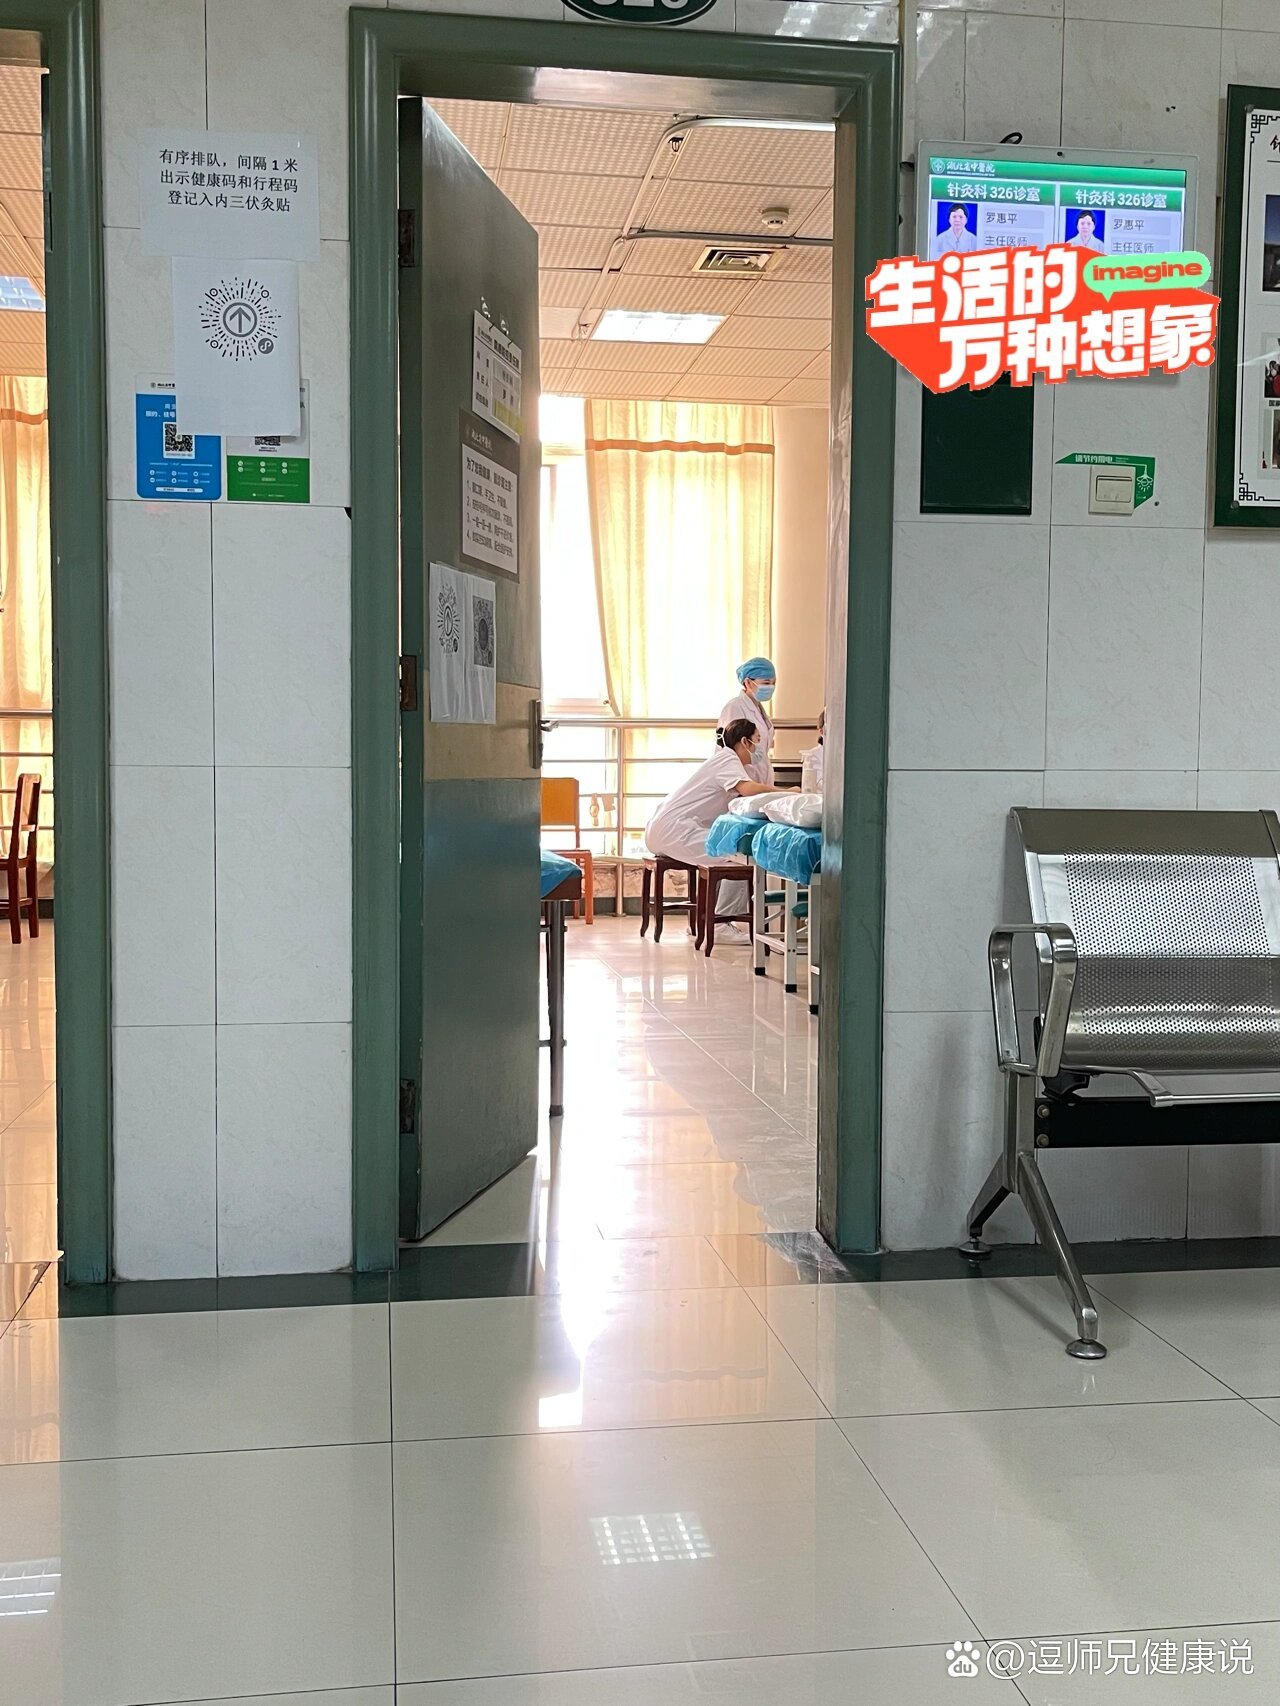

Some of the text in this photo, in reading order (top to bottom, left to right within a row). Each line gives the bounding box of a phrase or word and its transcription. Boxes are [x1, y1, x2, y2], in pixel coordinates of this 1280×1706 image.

[160, 169, 298, 193] 出示健康码和行程码
[947, 182, 1041, 202] 针灸科 326诊室
[1075, 189, 1168, 209] 针灸科 326诊室
[168, 190, 291, 213] 登记入内三伏灸贴
[986, 211, 1018, 225] 罗惠平
[1113, 218, 1145, 231] 罗惠平
[985, 235, 1028, 247] 主任医师
[1111, 242, 1155, 254] 主任医师
